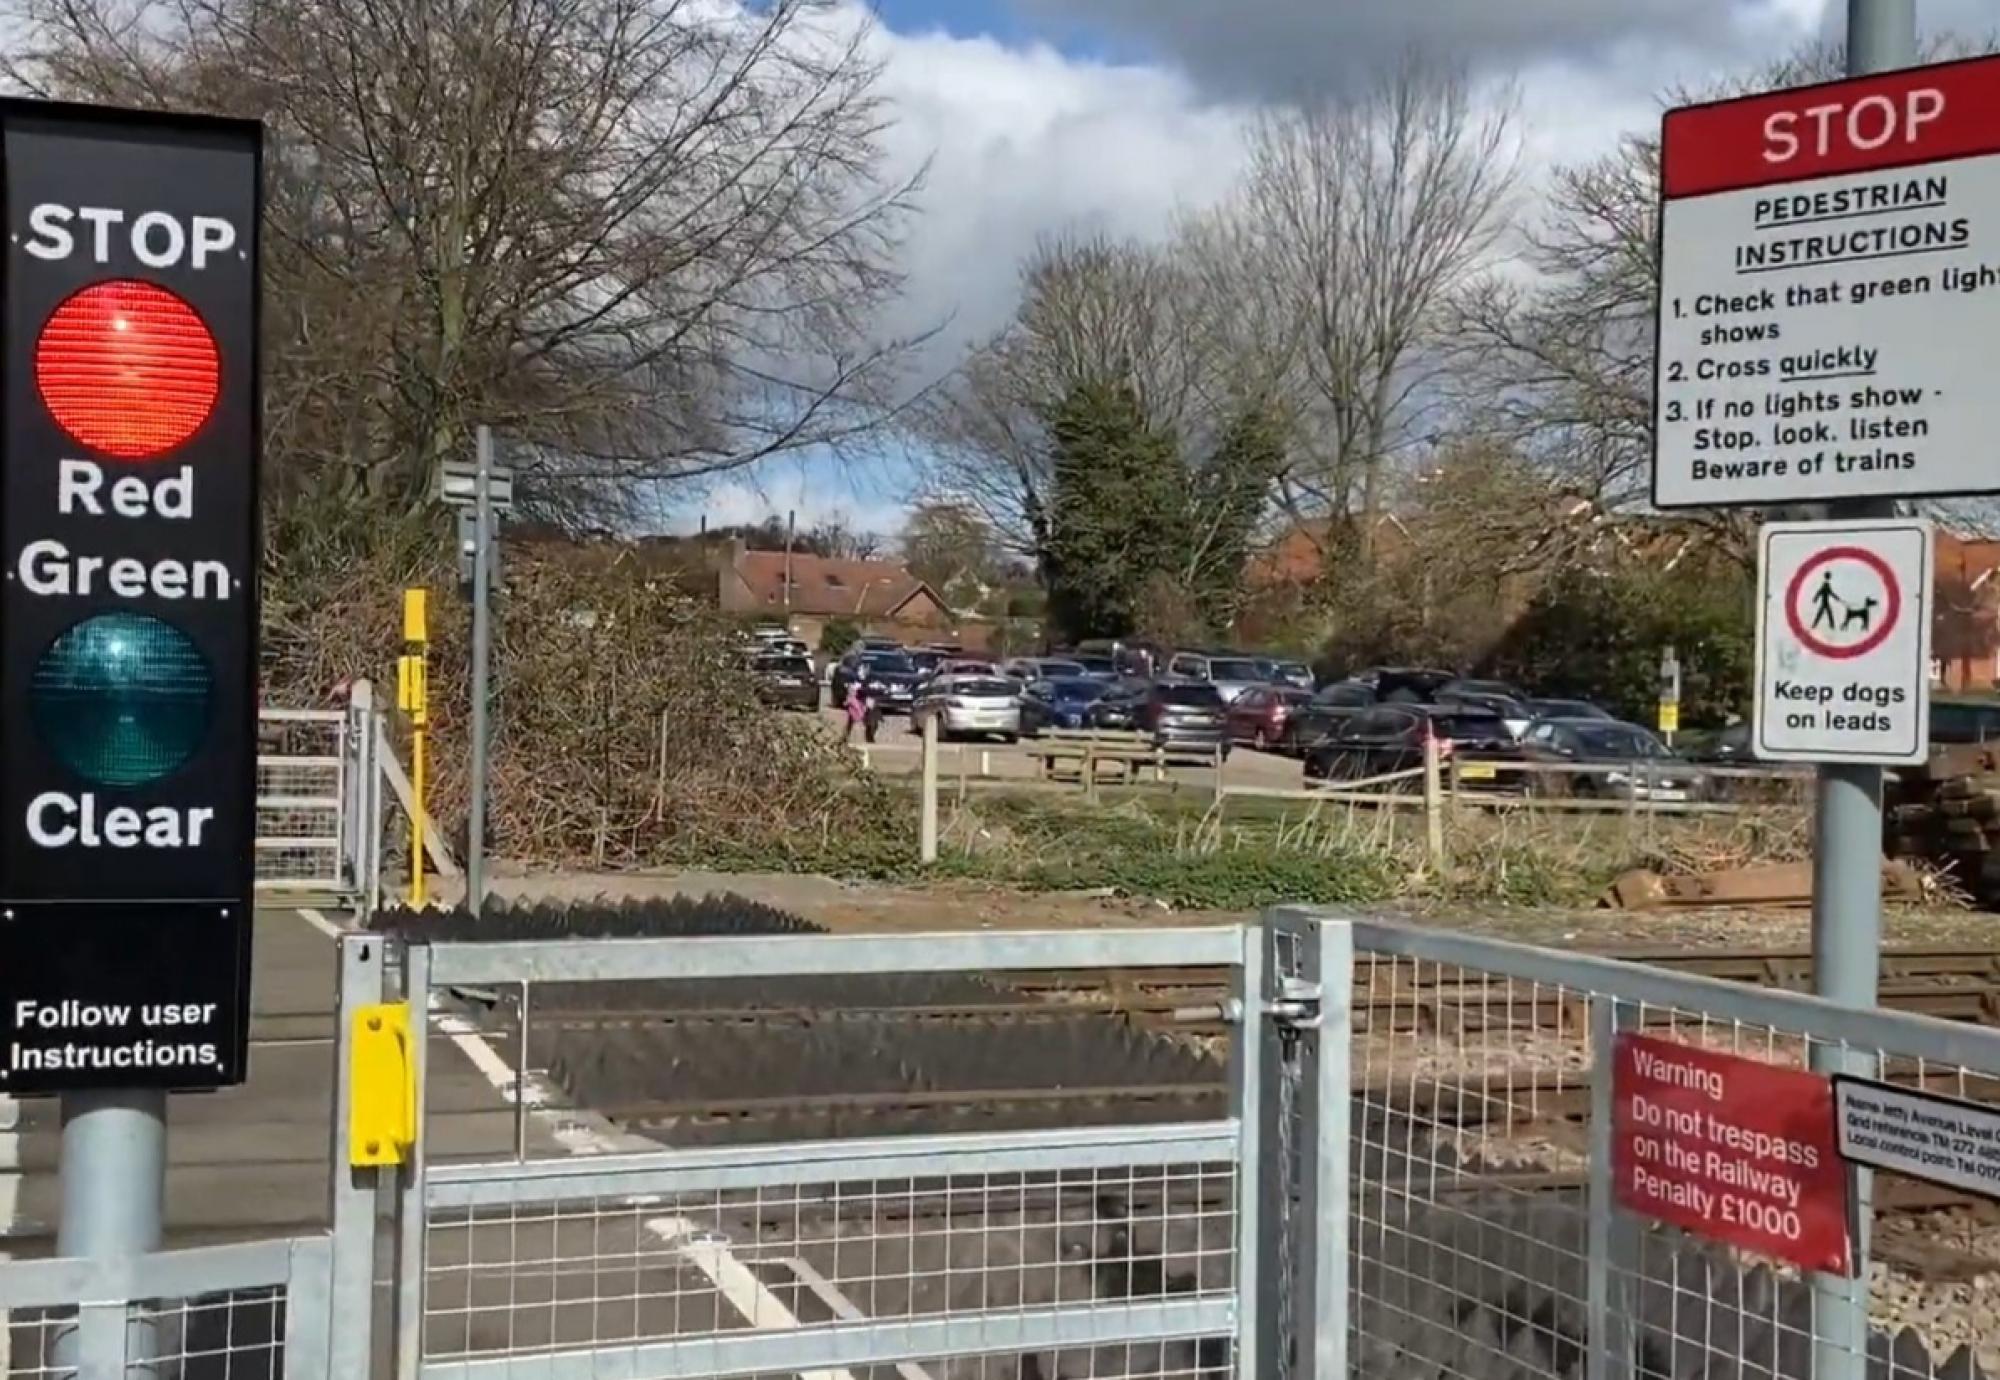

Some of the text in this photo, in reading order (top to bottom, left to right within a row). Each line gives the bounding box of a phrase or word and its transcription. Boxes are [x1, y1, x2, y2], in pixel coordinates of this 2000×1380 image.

[1762, 88, 1945, 163] STOP
[1755, 176, 1947, 222] PEDESTRIAN
[24, 203, 236, 270] STOP
[1736, 218, 1969, 267] INSTRUCTIONS
[1695, 289, 1775, 316] Check
[1786, 281, 1841, 307] that
[1851, 275, 1930, 303] green
[1943, 263, 2000, 293] ligh
[1701, 322, 1780, 345] shows
[1667, 345, 1878, 382] 2. Cross quickly
[1666, 401, 1688, 422] 3.
[1697, 399, 1714, 420] If
[1725, 401, 1754, 418] no
[1765, 391, 1840, 418] lights
[1850, 386, 1922, 409] show
[1851, 417, 1928, 440] listen
[1692, 448, 1915, 480] Beware of trains
[58, 459, 193, 519] Red
[18, 540, 229, 600] Green
[1774, 680, 1905, 707] Keep dogs
[1786, 710, 1891, 731] on leads
[26, 792, 214, 847] Clear
[15, 1000, 217, 1028] Follow user
[11, 1041, 217, 1071] Instructions
[1632, 1047, 1724, 1101] Warning
[1632, 1095, 1819, 1168] Do not trespass
[1633, 1136, 1801, 1208] on the Railway
[1633, 1166, 1801, 1240] Penalty £1000
